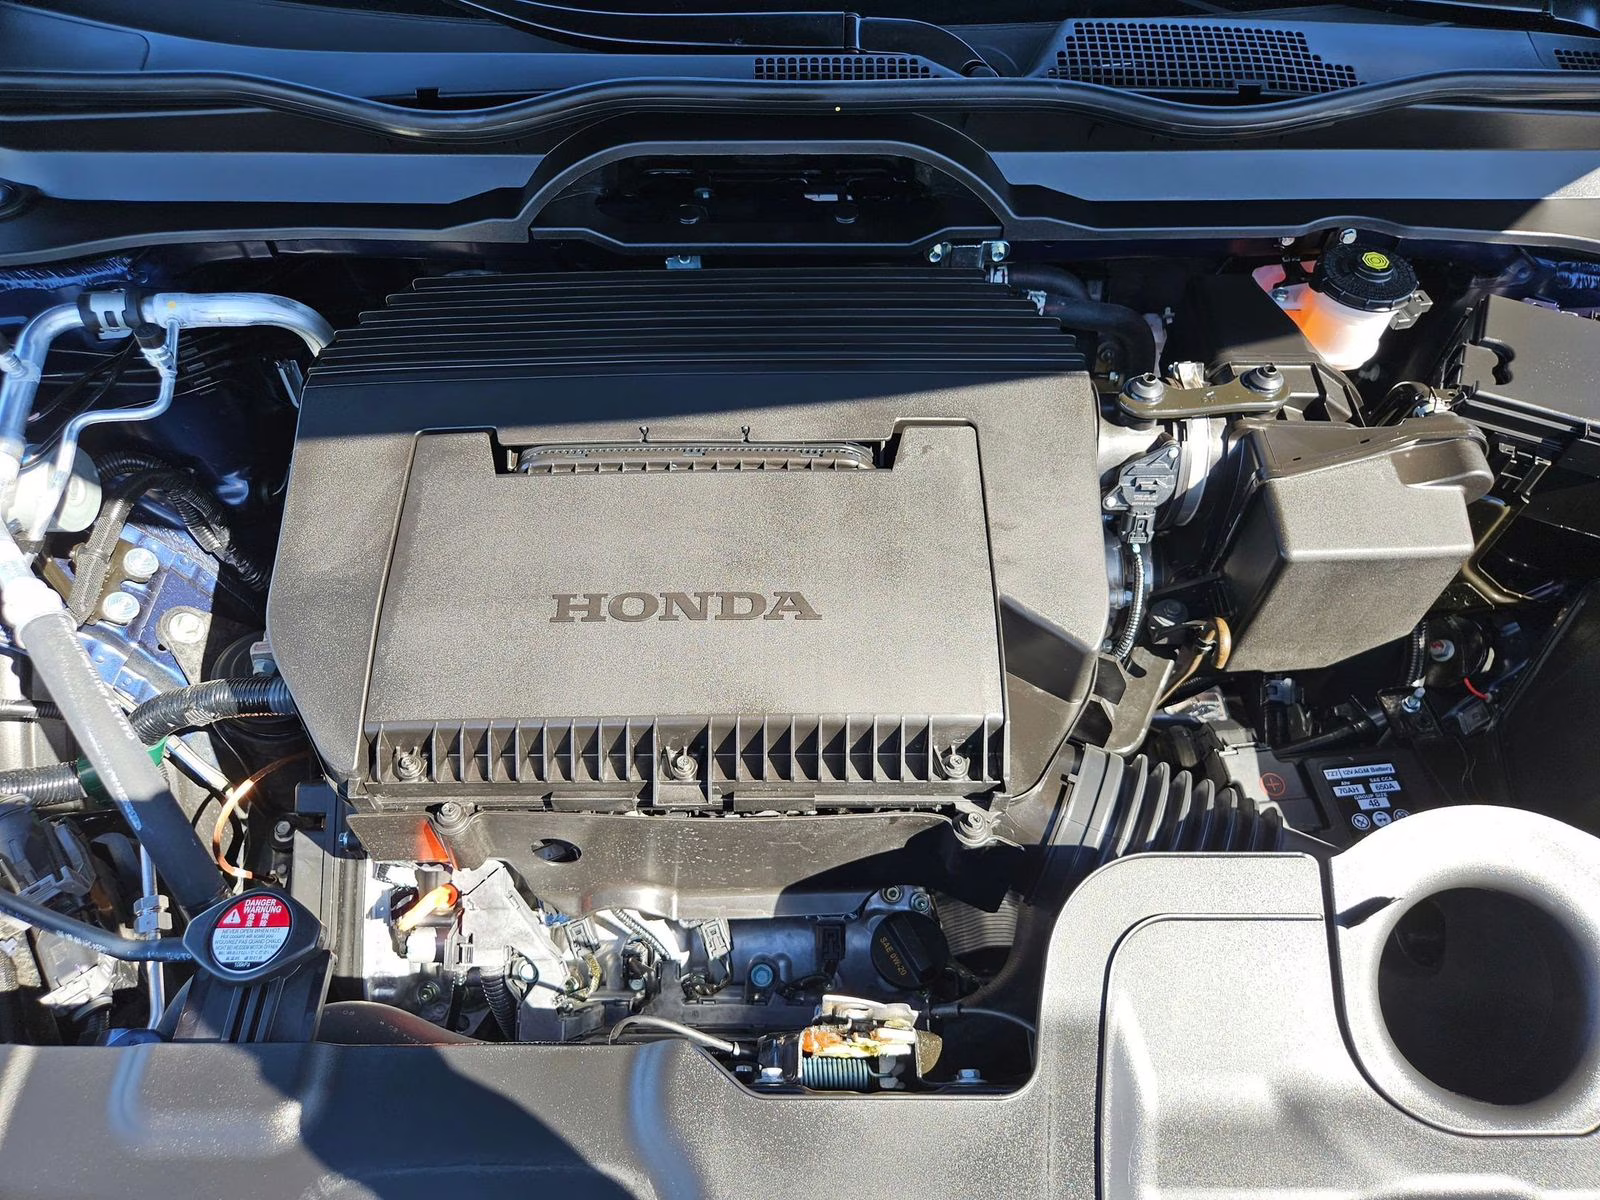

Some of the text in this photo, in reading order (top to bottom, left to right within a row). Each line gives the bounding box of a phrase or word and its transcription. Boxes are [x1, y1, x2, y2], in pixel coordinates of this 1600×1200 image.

[549, 591, 823, 623] HONDA
[1368, 799, 1381, 808] 48
[243, 905, 282, 914] WARNUNG
[880, 936, 907, 976] SAE 0W-20
